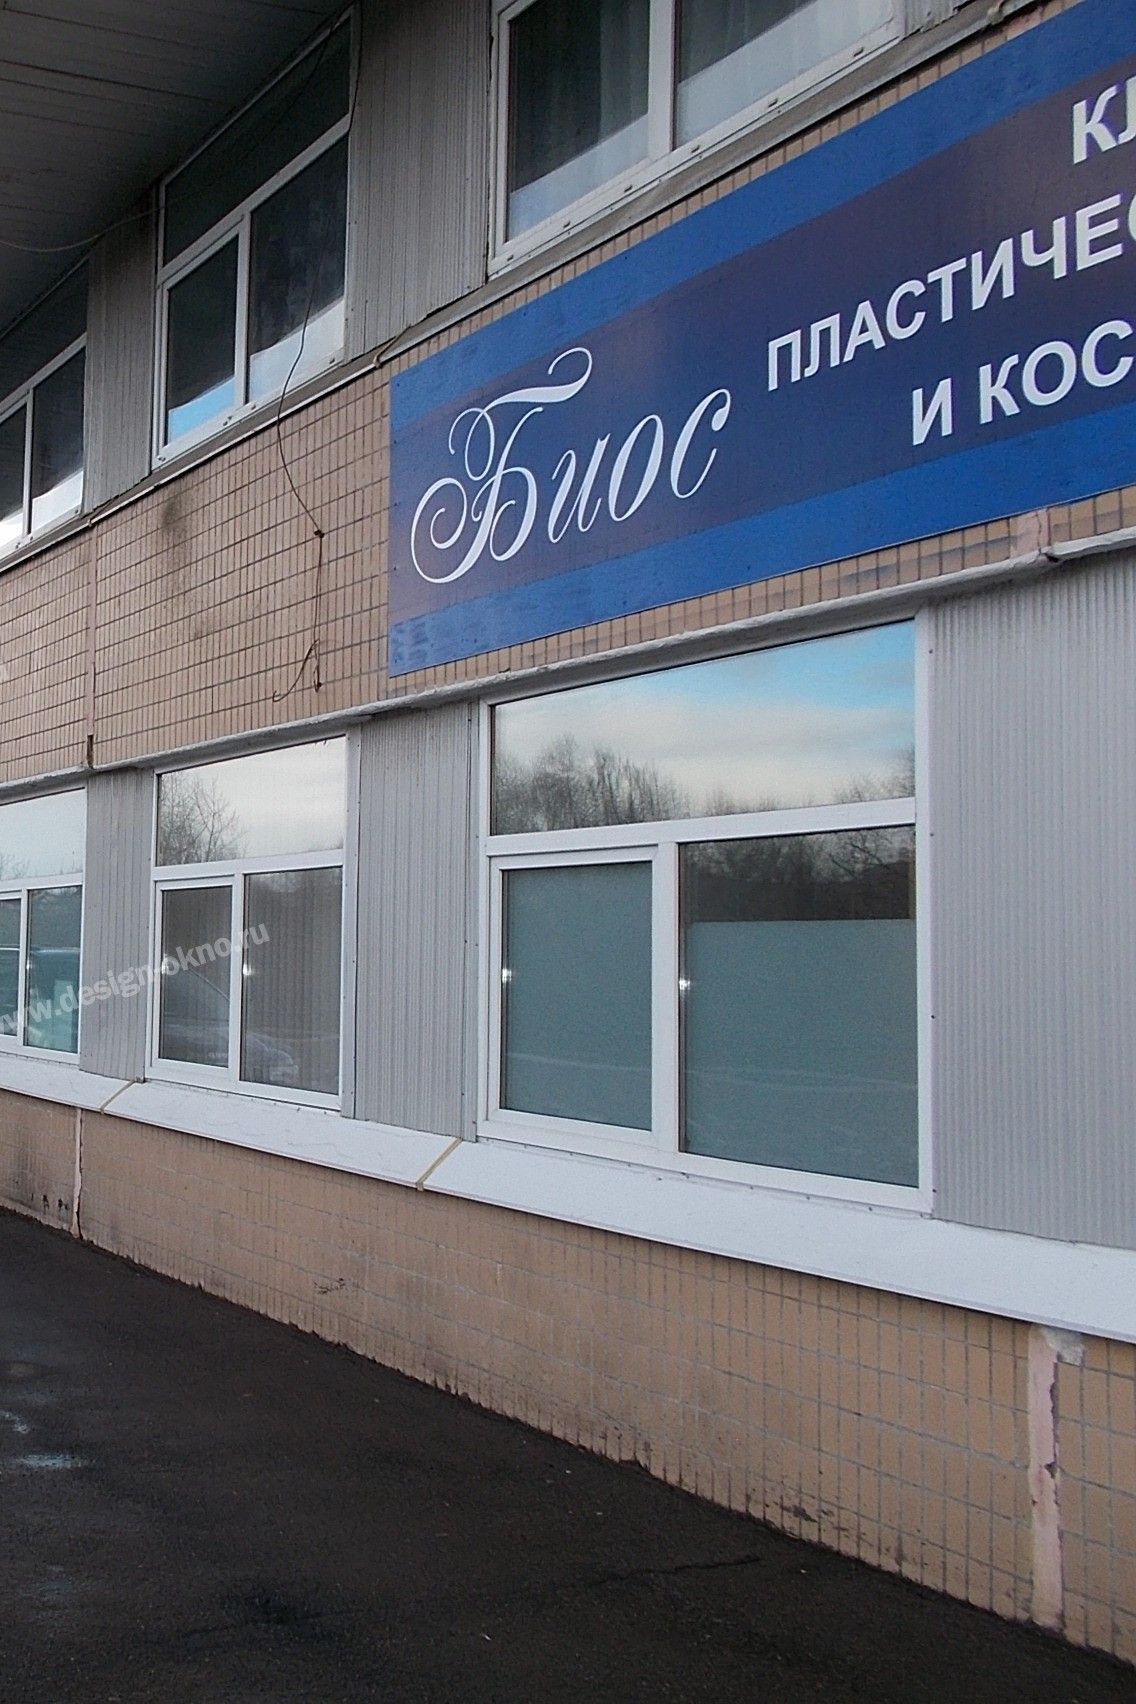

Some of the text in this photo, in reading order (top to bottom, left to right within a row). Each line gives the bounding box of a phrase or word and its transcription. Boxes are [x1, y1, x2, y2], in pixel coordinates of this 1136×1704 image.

[768, 193, 1136, 391] ПЛАСТИЧЕ
[912, 320, 1135, 446] И КОС
[411, 347, 731, 583] Биос
